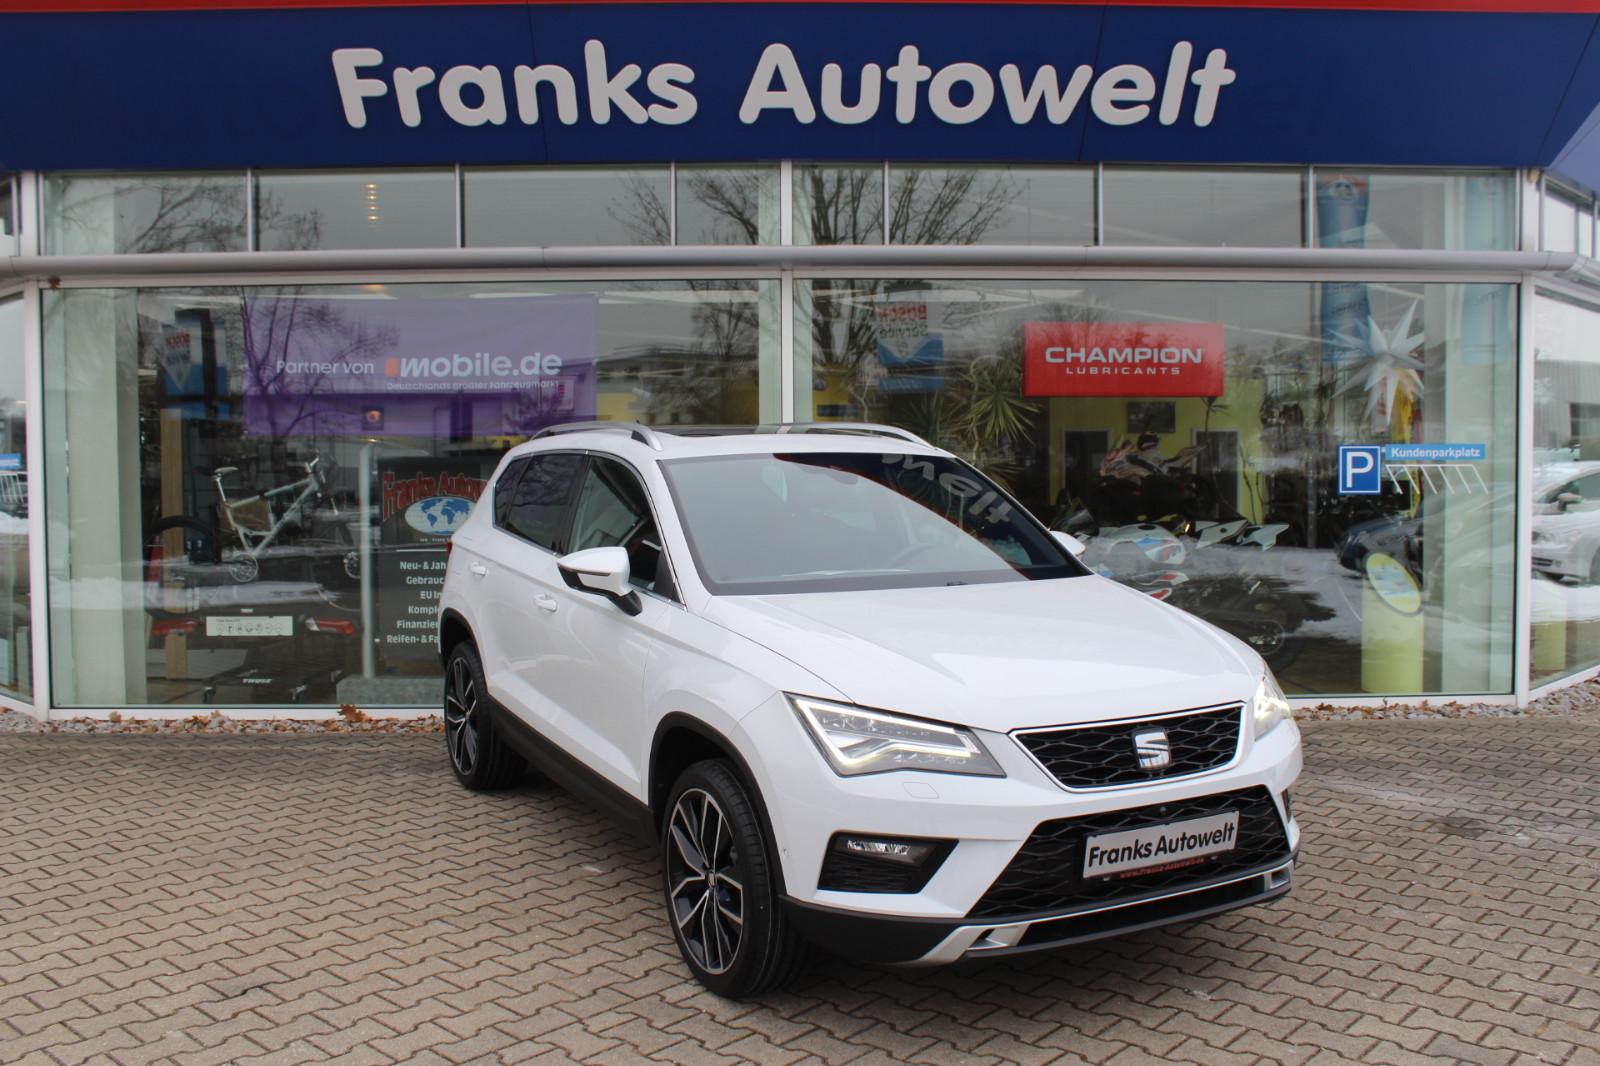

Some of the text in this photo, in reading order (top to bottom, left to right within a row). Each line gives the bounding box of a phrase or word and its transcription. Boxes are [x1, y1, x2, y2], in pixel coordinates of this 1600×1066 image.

[331, 39, 1237, 128] Franks Autowelt
[1044, 346, 1203, 364] CHAMPION
[276, 351, 563, 378] Partner von mobile.de
[1066, 367, 1181, 375] LUBRICANTS
[1391, 447, 1481, 460] Kundenparkplatz
[1346, 451, 1374, 488] P
[399, 561, 421, 570] Neu-
[423, 561, 430, 570] &
[420, 590, 432, 599] EU
[386, 635, 419, 644] Reifen-
[421, 635, 428, 644] &
[1087, 822, 1235, 868] Franks Autowelt
